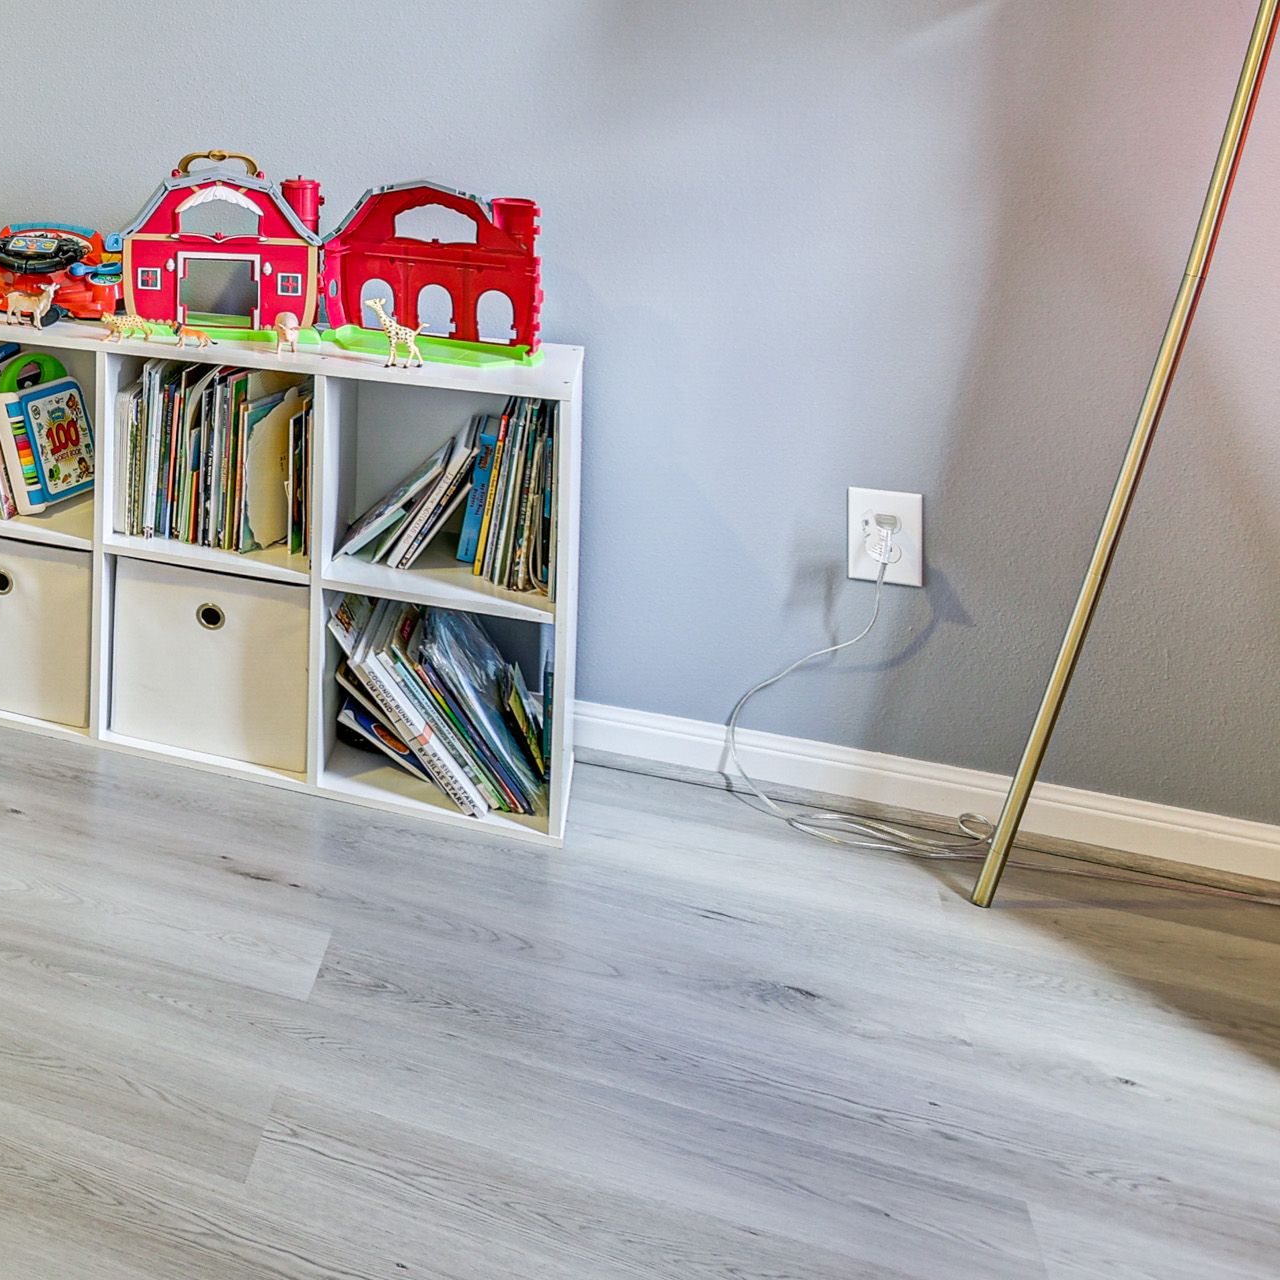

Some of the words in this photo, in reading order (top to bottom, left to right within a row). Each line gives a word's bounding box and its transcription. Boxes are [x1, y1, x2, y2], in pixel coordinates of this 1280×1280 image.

[46, 420, 80, 456] 100
[366, 681, 377, 695] UM
[376, 693, 393, 713] LAND
[368, 670, 395, 703] COCONUT
[395, 704, 415, 727] BUNNY
[418, 747, 428, 757] BY
[427, 760, 445, 780] SILAS
[445, 782, 466, 807] STARK
[432, 752, 441, 762] BY
[441, 762, 459, 785] SILAS
[458, 786, 478, 809] STARK
